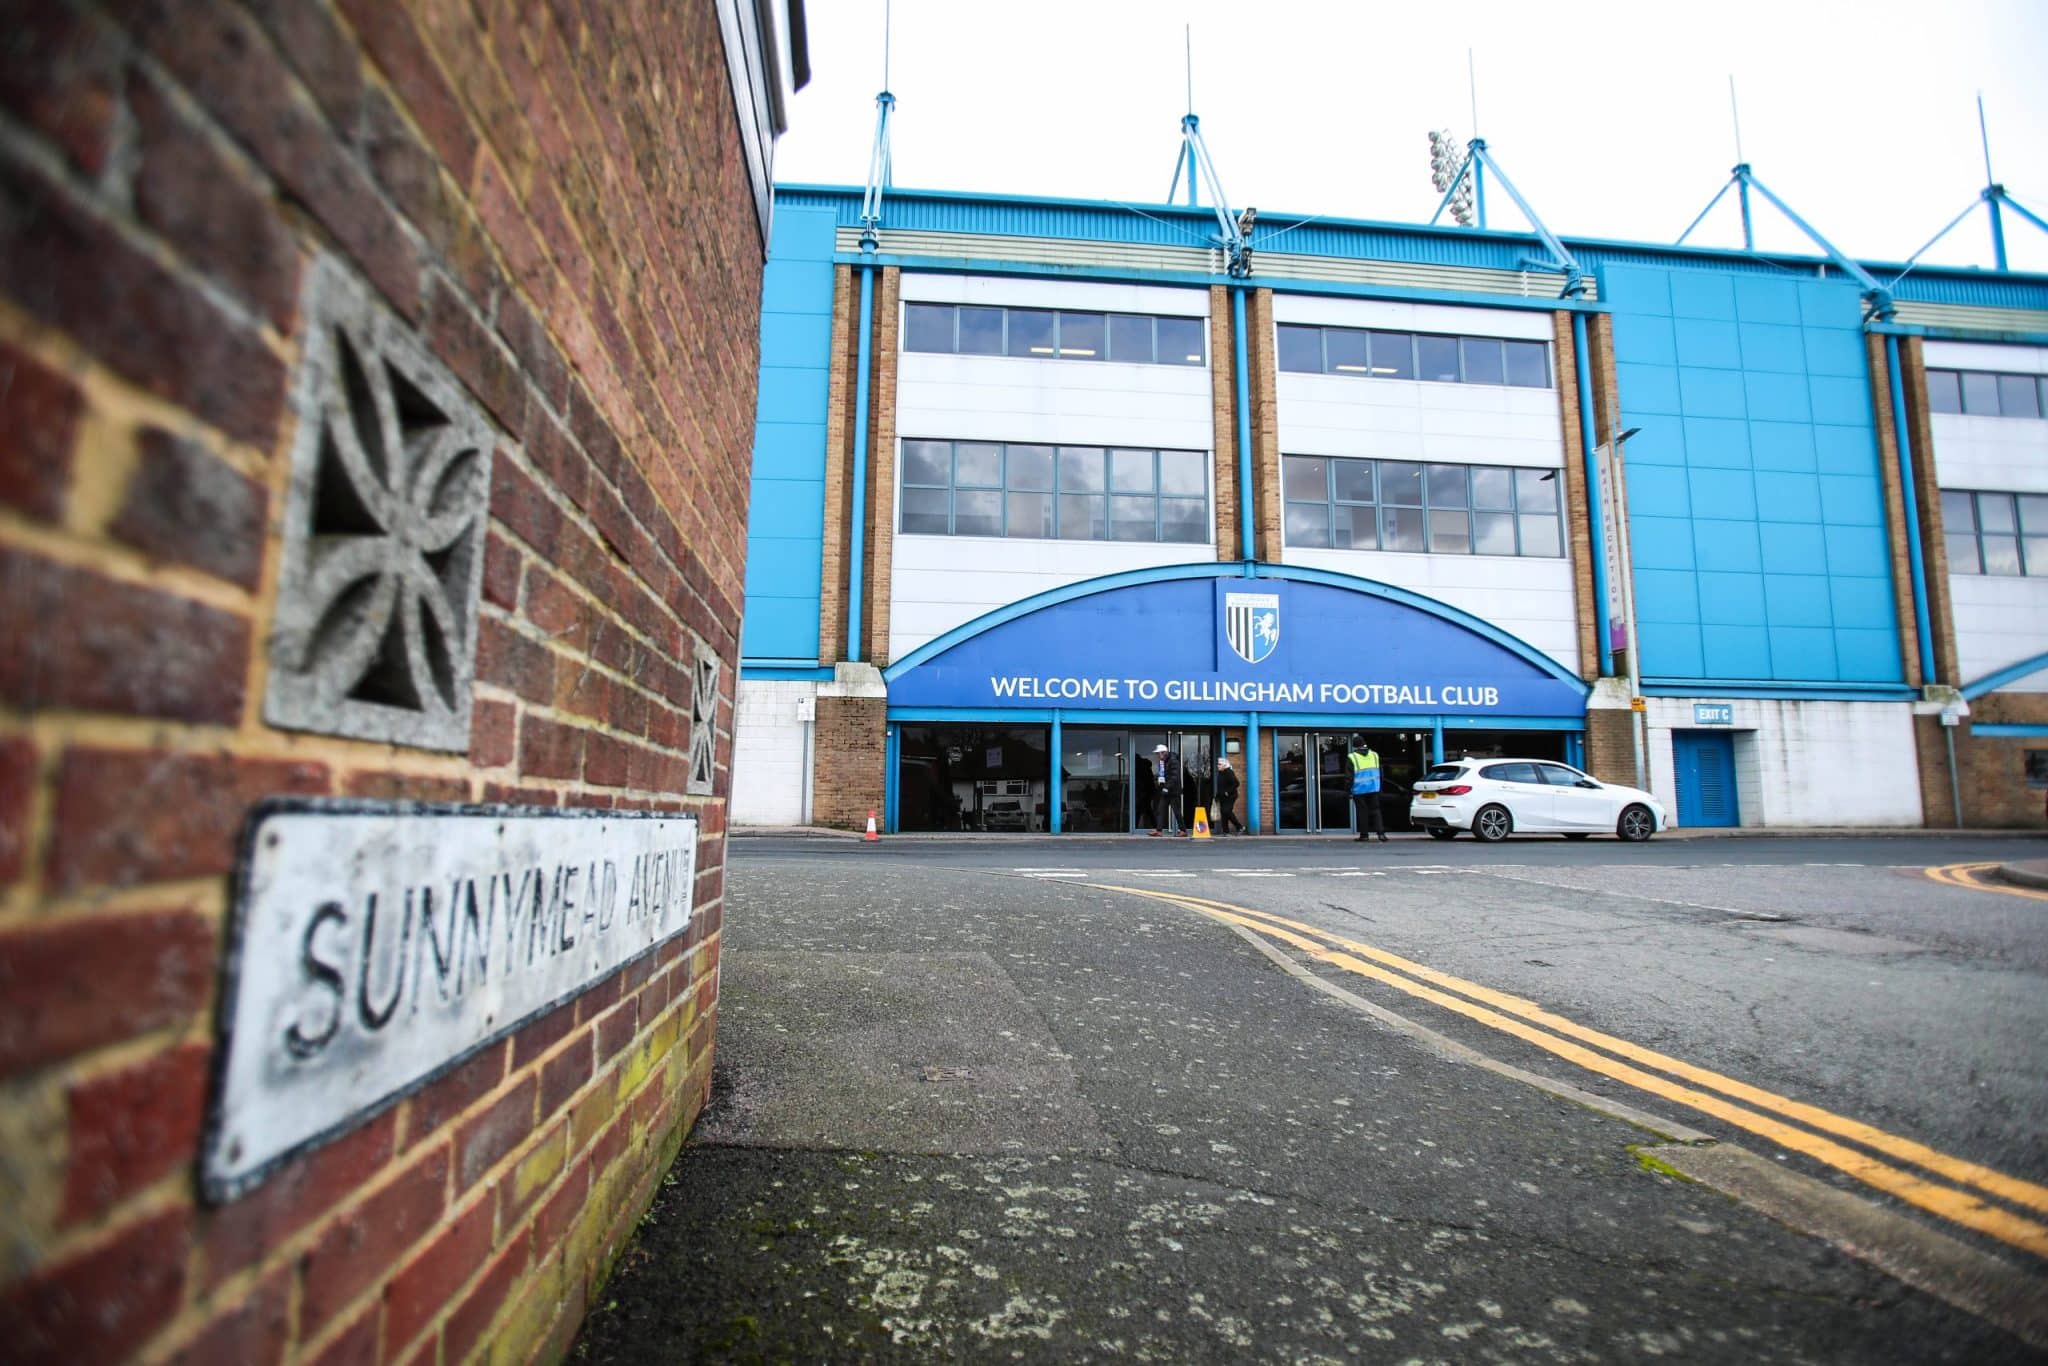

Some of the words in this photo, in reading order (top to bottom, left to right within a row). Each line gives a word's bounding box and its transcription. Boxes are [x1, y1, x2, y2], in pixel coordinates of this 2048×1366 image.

[990, 676, 1119, 699] WELCOME
[1124, 679, 1158, 700] TO
[1164, 680, 1314, 703] GILLINGHAM
[1320, 683, 1438, 705] FOOTBALL
[1441, 686, 1499, 706] CLUB
[1700, 708, 1720, 720] EXIT
[284, 857, 618, 1060] SUNNYMEAD
